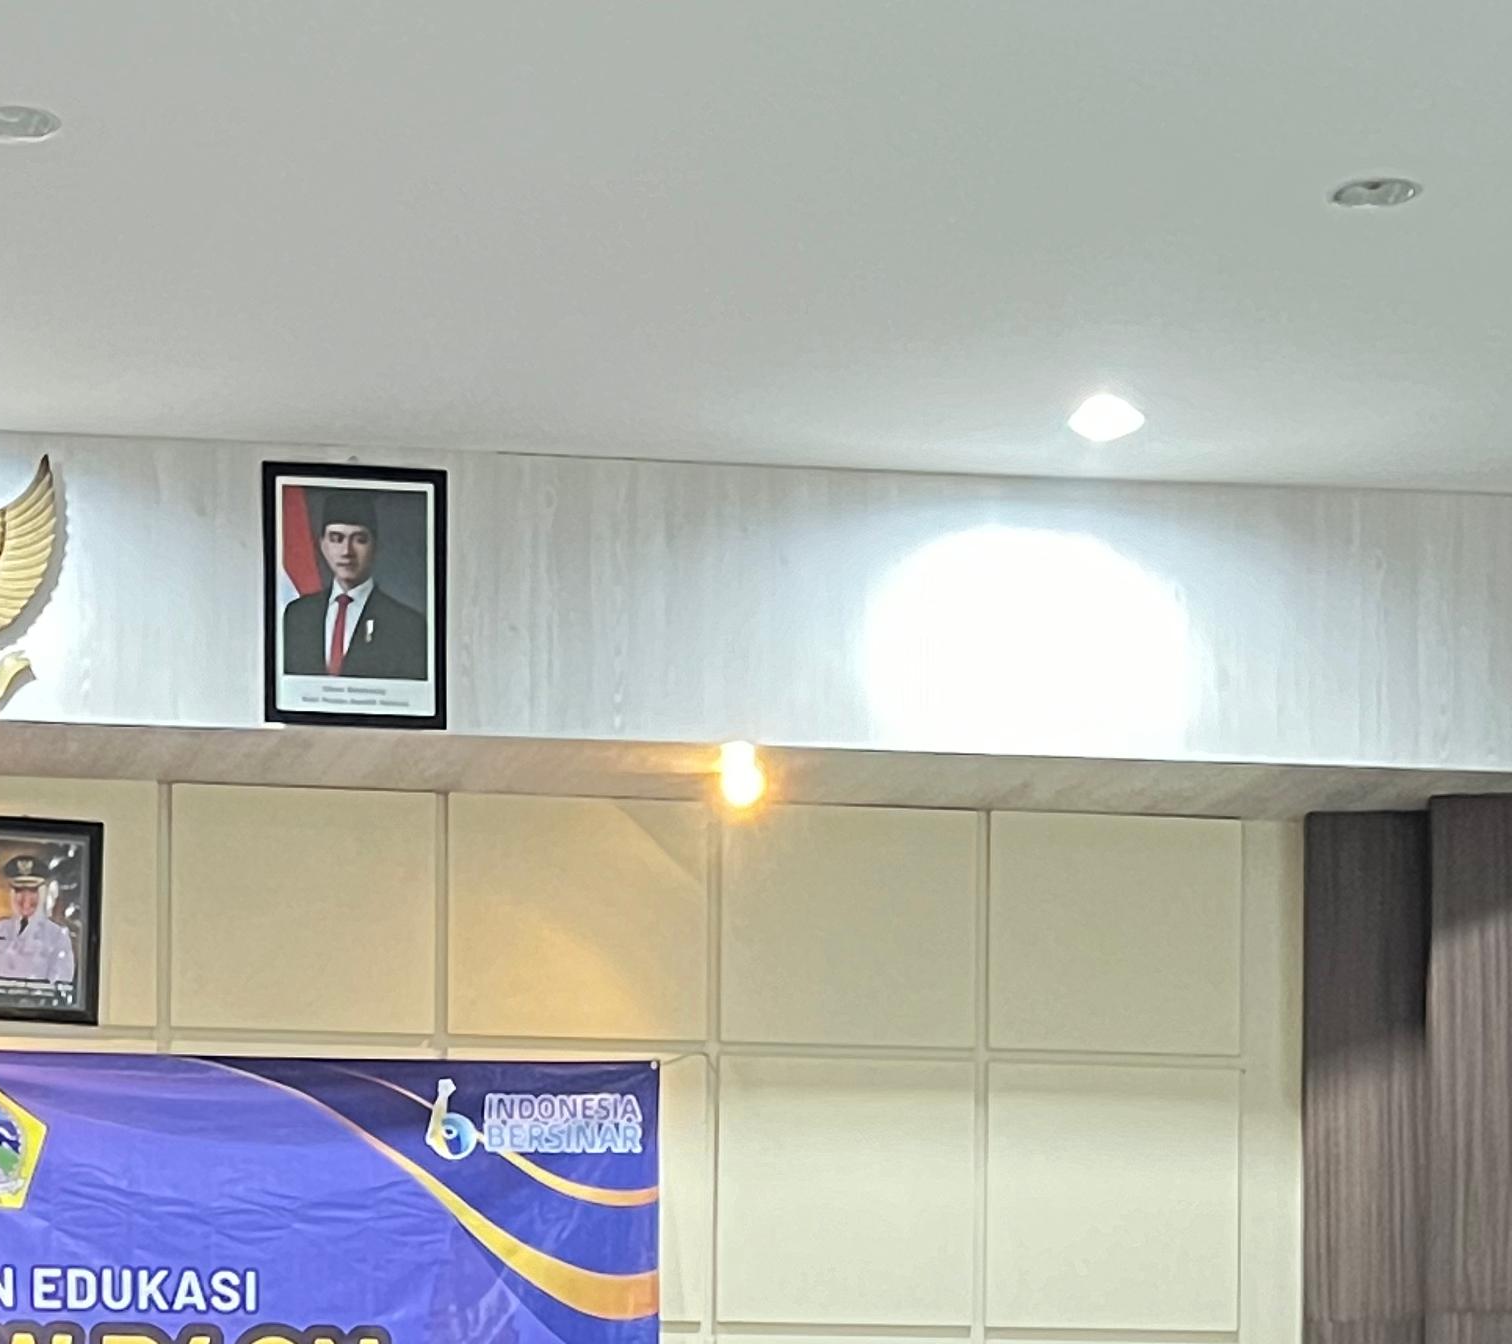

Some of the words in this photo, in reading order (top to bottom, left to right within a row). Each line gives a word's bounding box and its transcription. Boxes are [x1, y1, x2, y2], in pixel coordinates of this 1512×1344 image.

[486, 1096, 641, 1121] INDONESIA
[486, 1122, 641, 1150] BERSINAR
[32, 1269, 258, 1312] EDUKASI
